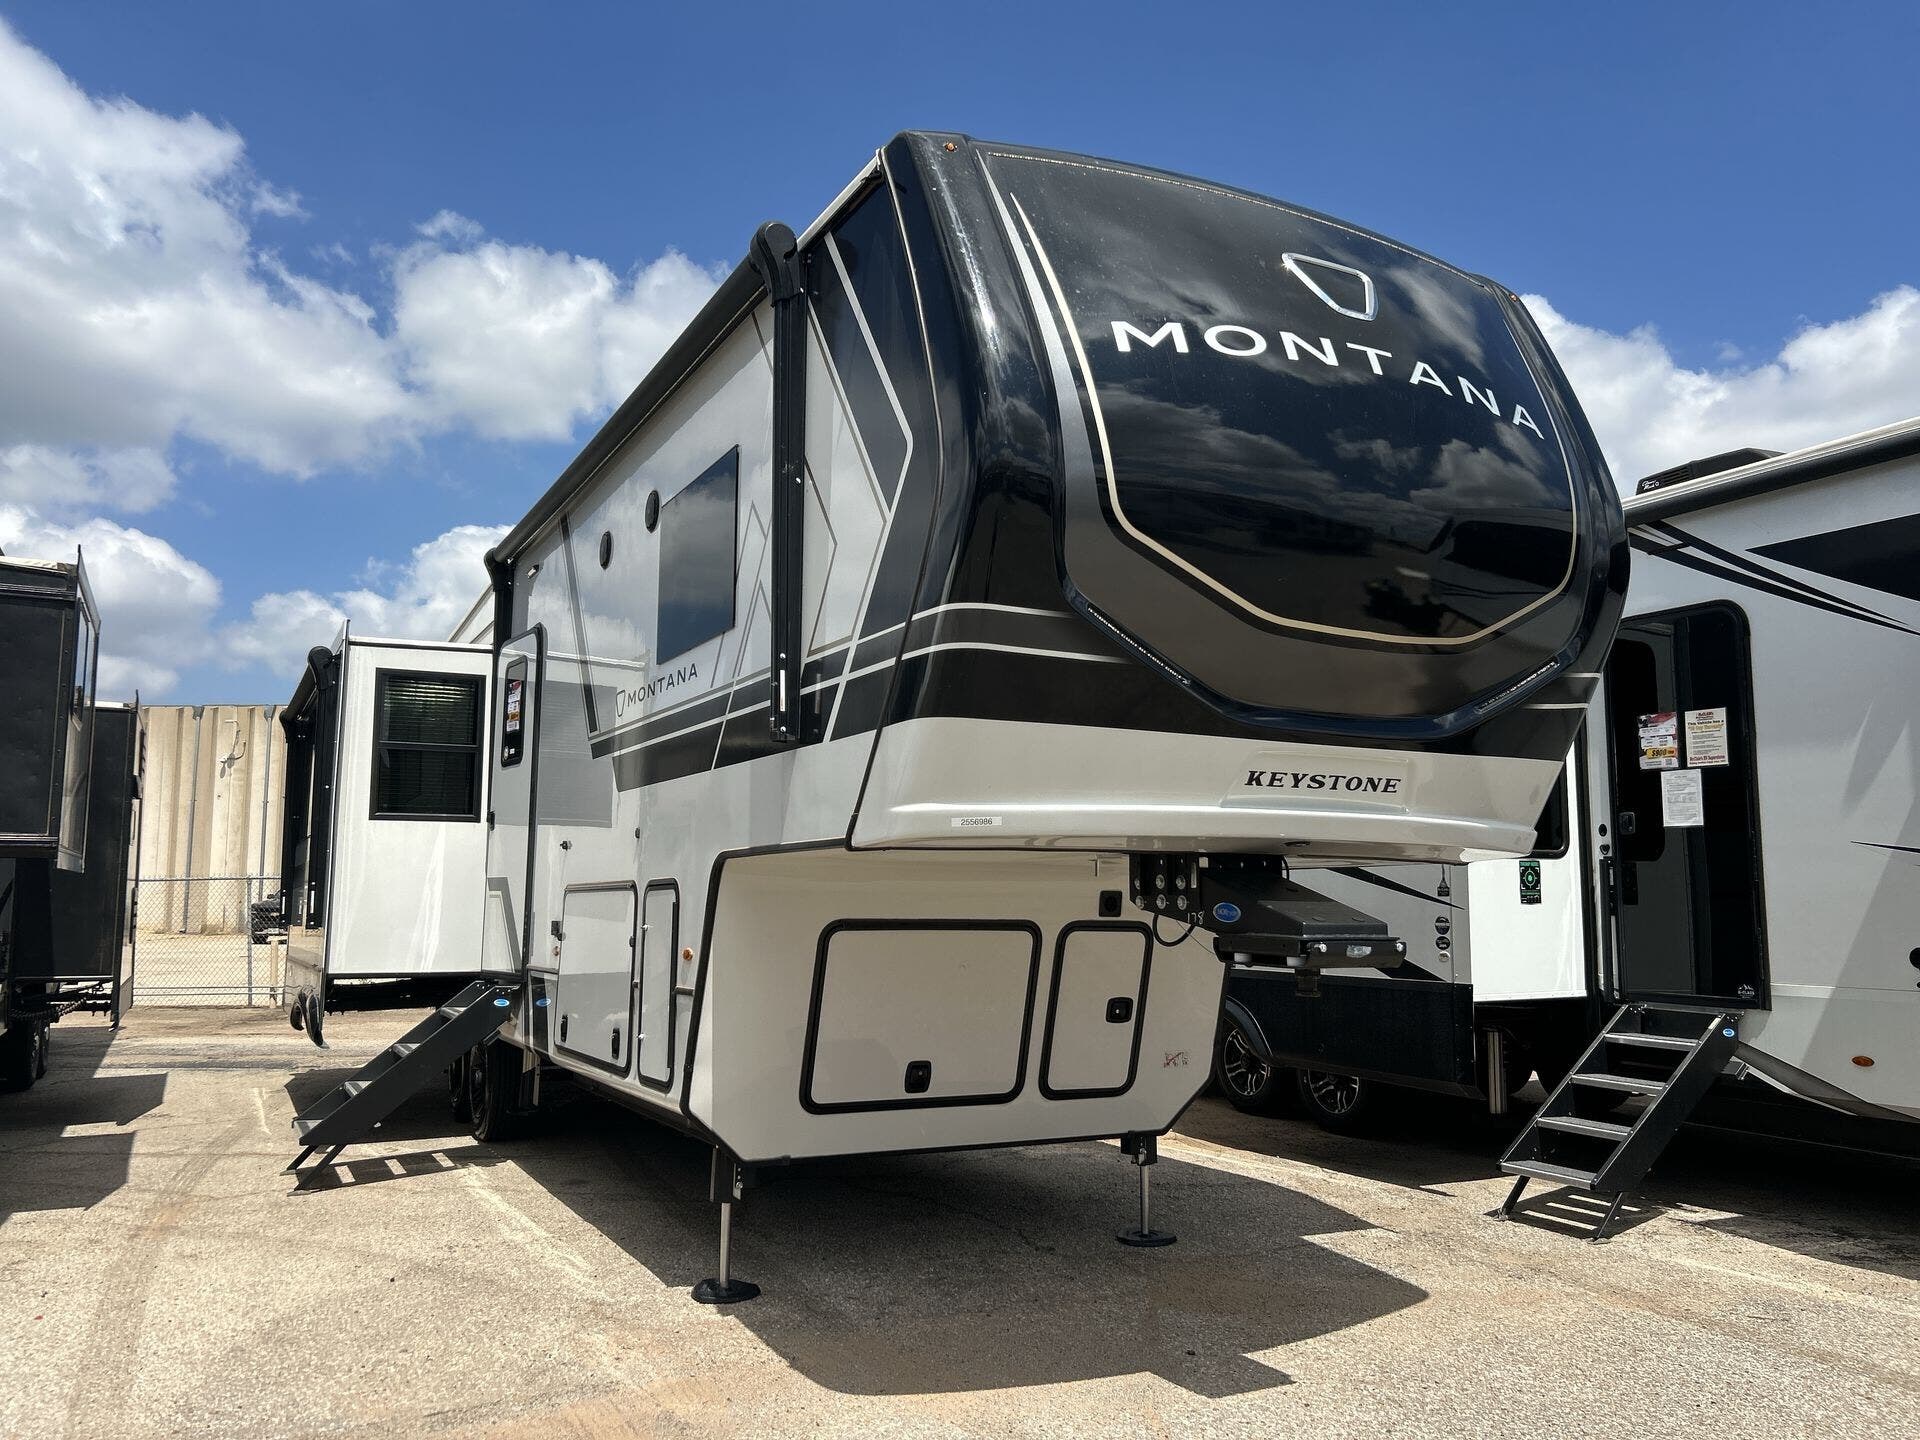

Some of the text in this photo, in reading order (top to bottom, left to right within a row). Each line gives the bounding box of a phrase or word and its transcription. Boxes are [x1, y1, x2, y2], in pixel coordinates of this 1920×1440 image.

[1110, 320, 1545, 440] MONTANA
[627, 662, 698, 708] MONTANA
[1244, 770, 1402, 794] KEYSTONE
